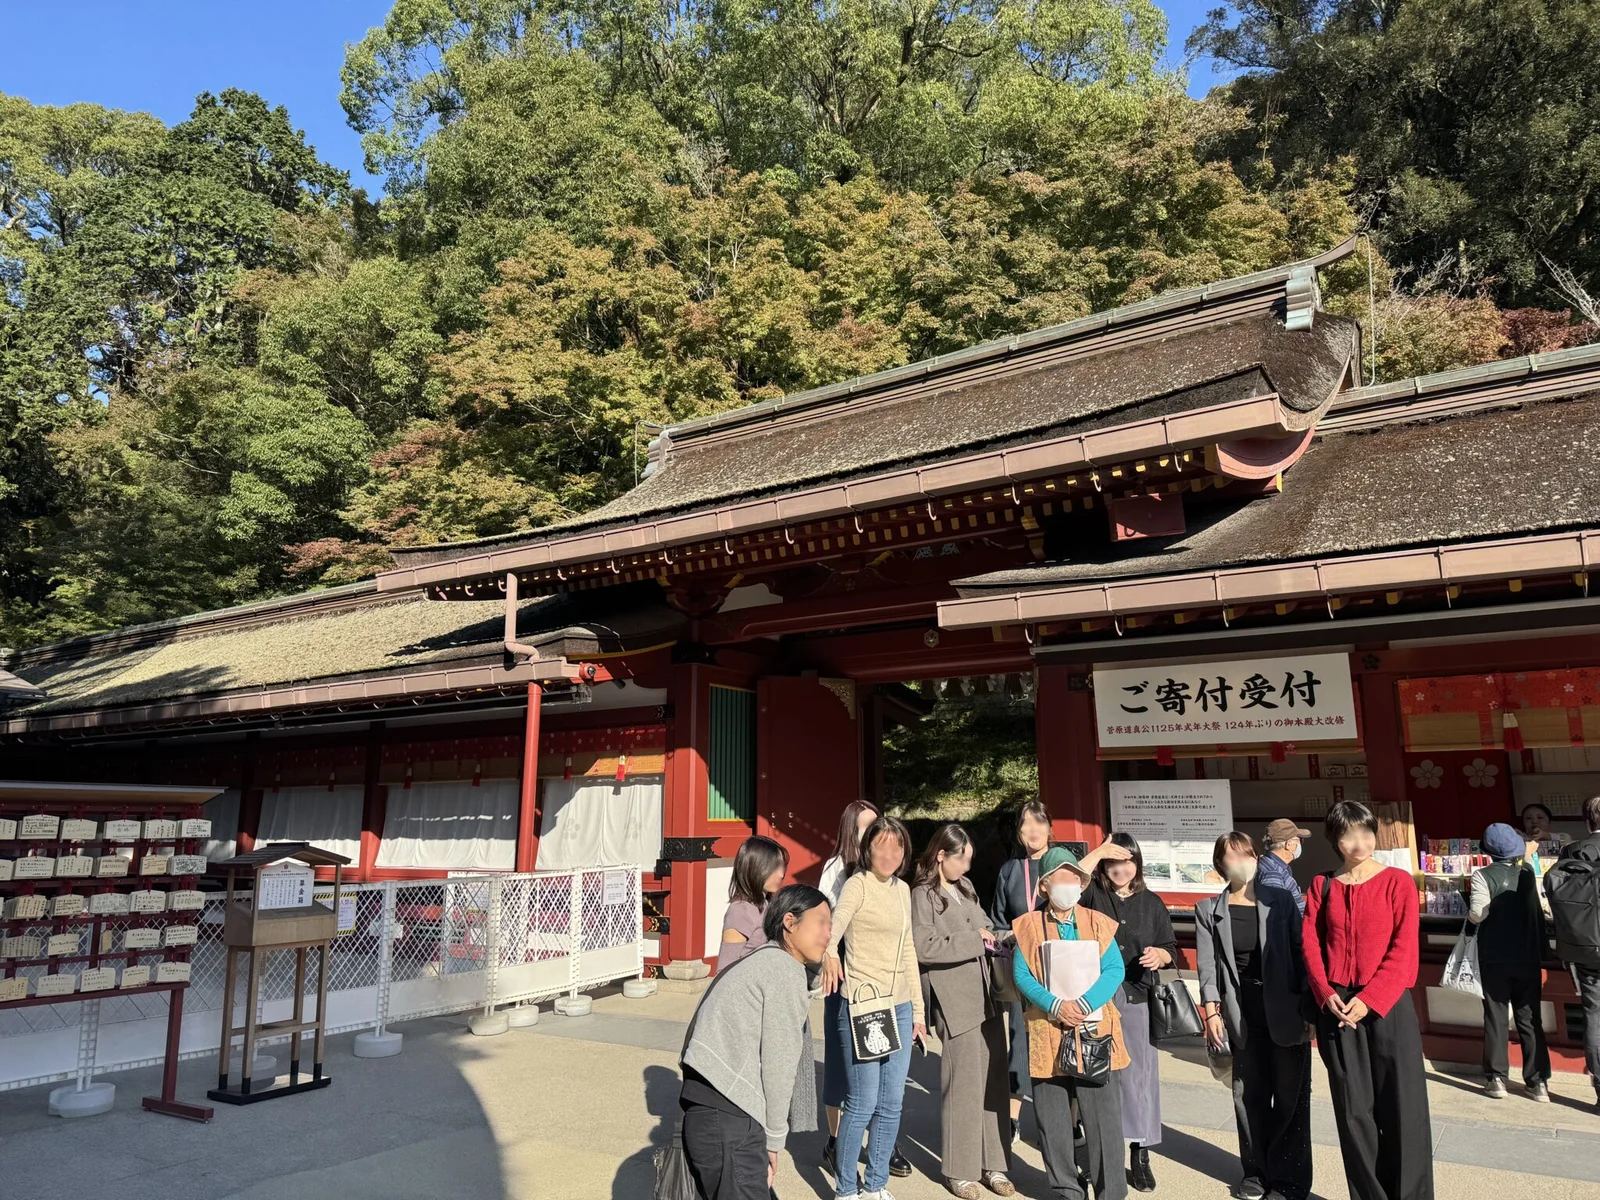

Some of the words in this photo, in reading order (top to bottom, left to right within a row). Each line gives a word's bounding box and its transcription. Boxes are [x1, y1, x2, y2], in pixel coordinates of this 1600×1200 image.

[1119, 669, 1322, 715] ご寄付受付
[1106, 720, 1221, 735] 菅原道真公1125年式年大祭
[1225, 715, 1345, 730] 124年ぶりの御本殿大改修
